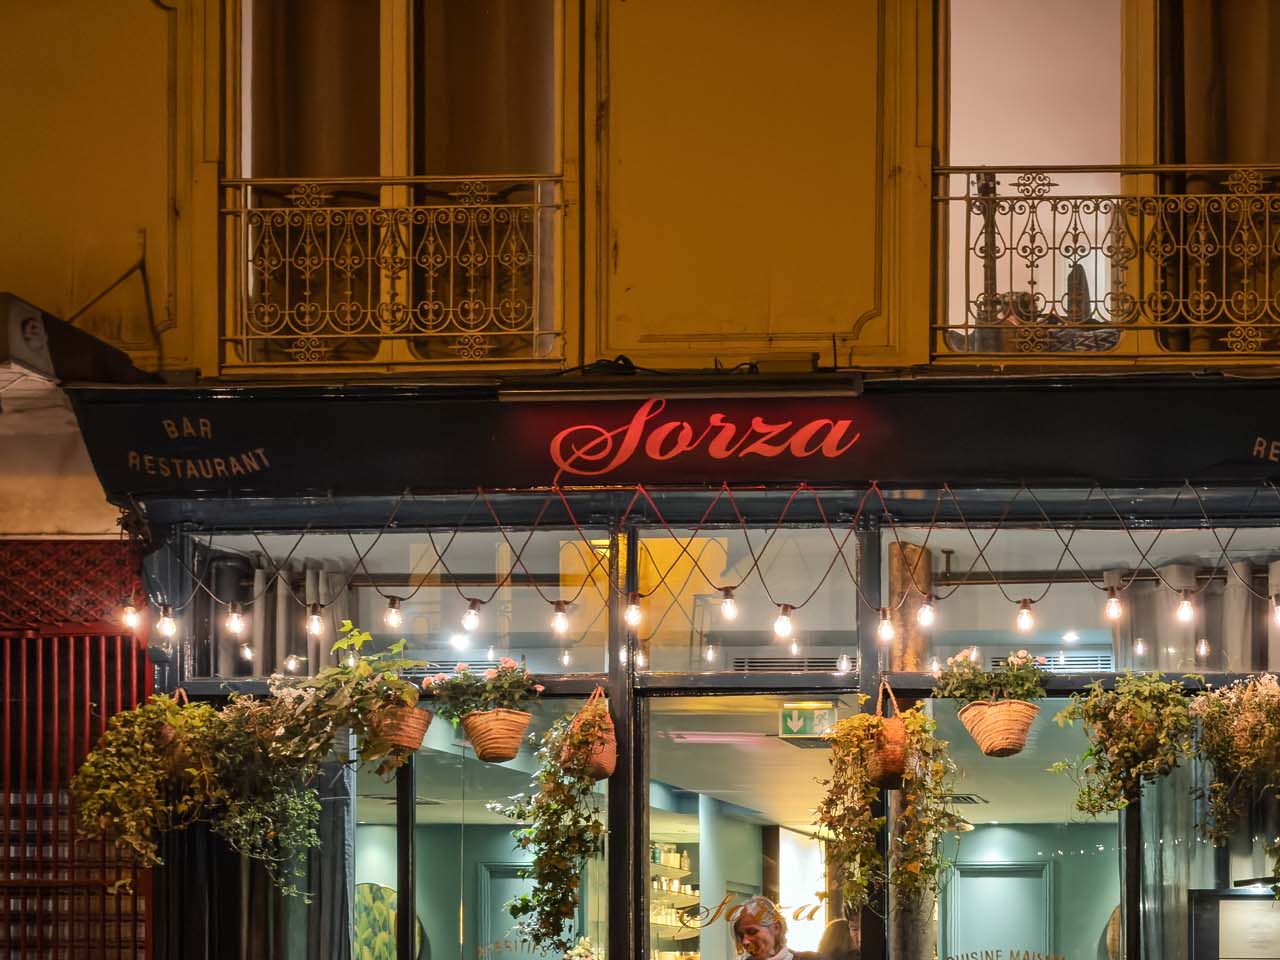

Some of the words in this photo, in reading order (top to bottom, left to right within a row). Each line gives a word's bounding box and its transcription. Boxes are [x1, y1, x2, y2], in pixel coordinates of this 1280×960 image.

[163, 416, 212, 439] BAR
[550, 398, 861, 482] Sorza
[128, 448, 270, 479] RESTAURANT
